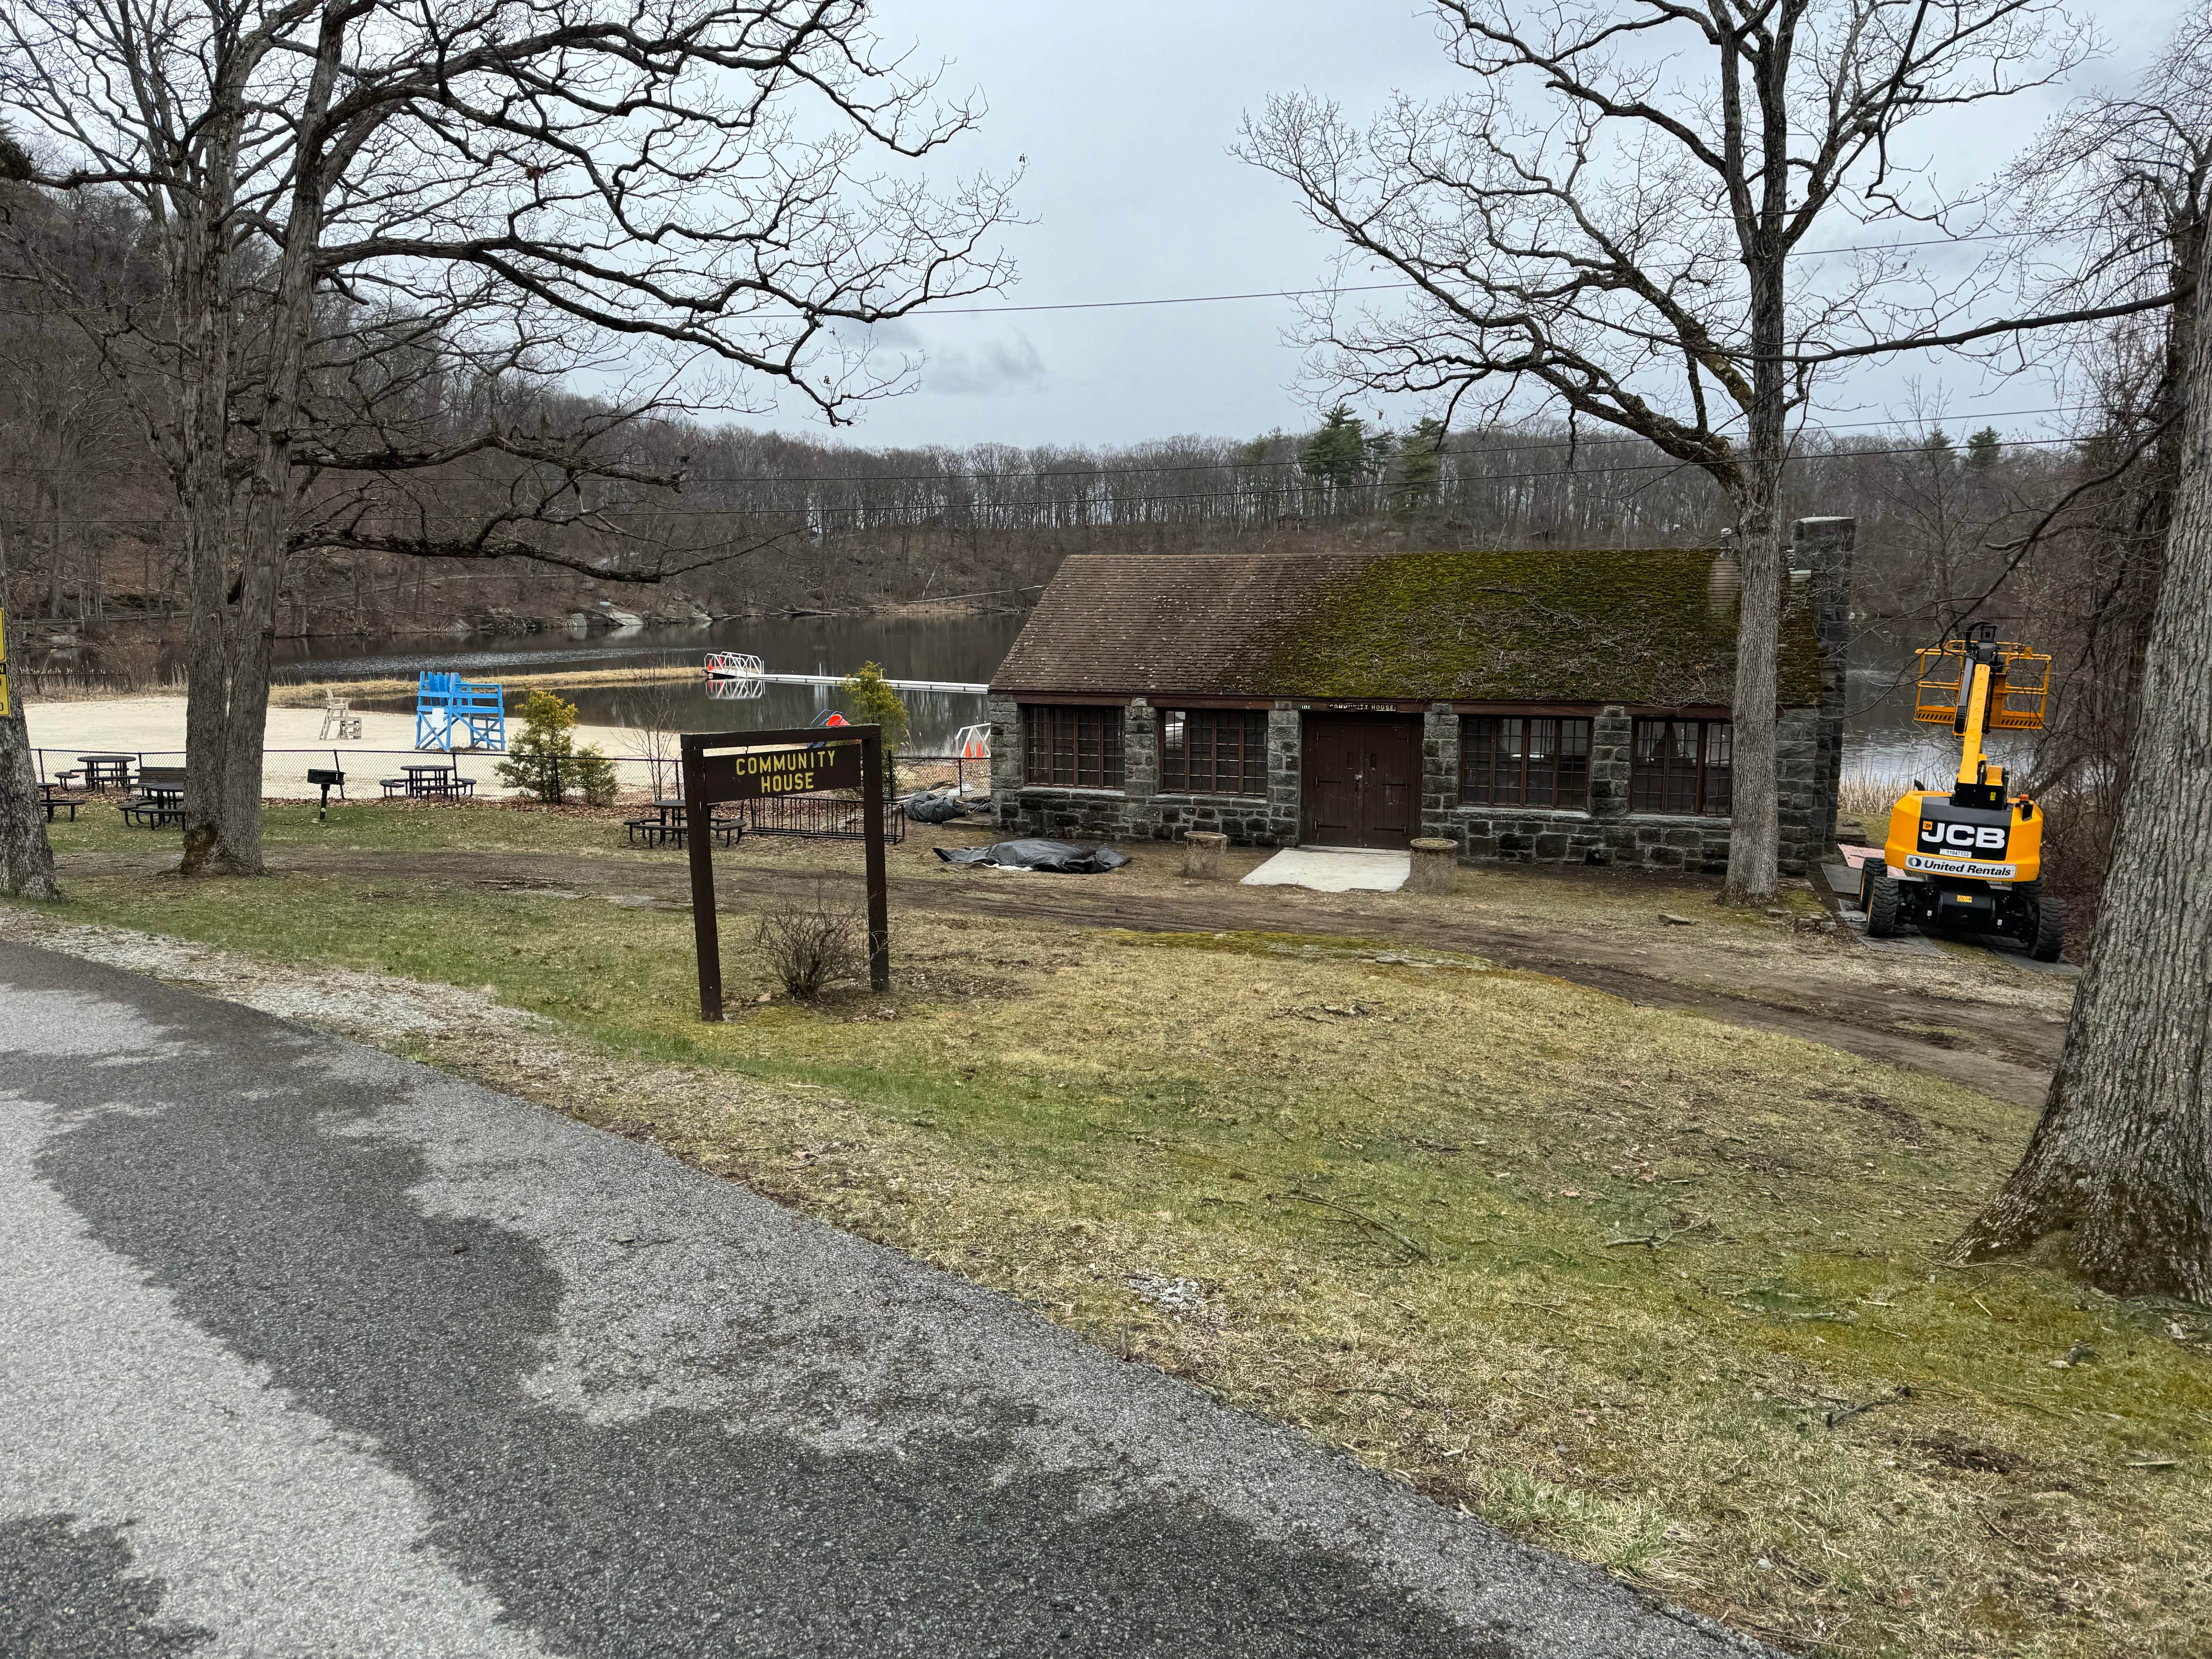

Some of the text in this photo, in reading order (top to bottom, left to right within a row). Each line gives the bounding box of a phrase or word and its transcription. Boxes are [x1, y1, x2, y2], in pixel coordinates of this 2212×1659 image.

[736, 750, 835, 775] COMMUNITY
[761, 772, 814, 793] HOUSE
[1922, 823, 2005, 848] JCB
[1924, 860, 2011, 876] United Rentals
